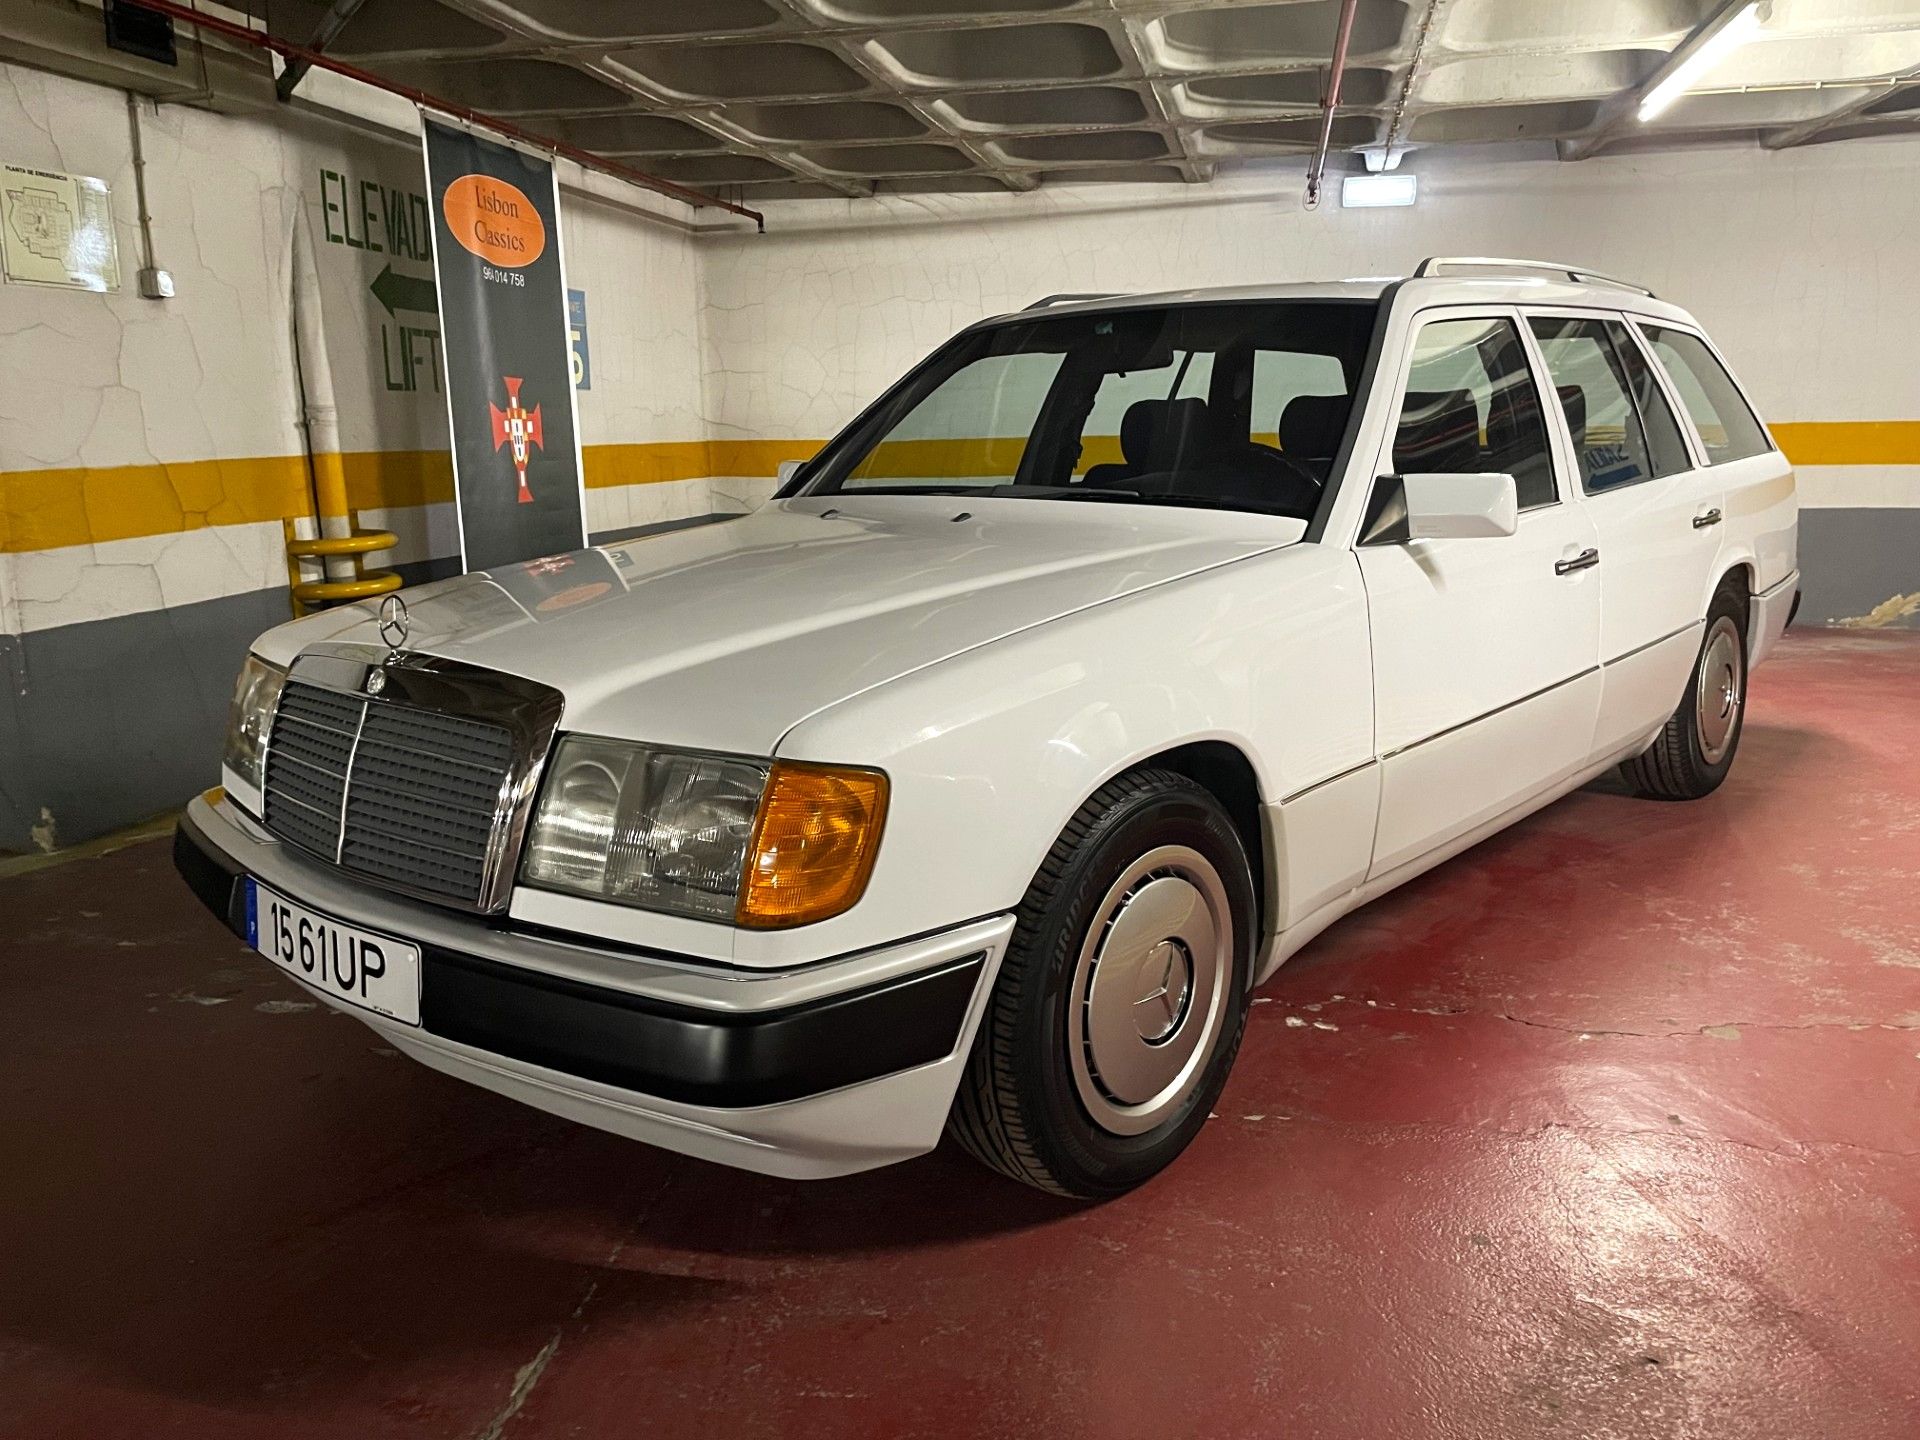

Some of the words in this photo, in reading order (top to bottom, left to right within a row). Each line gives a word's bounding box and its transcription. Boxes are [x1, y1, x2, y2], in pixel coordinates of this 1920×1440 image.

[320, 169, 434, 263] ELEVAD
[475, 185, 519, 219] Lisbon
[474, 220, 526, 253] Classics
[509, 272, 525, 288] 758
[382, 324, 440, 393] LIFT
